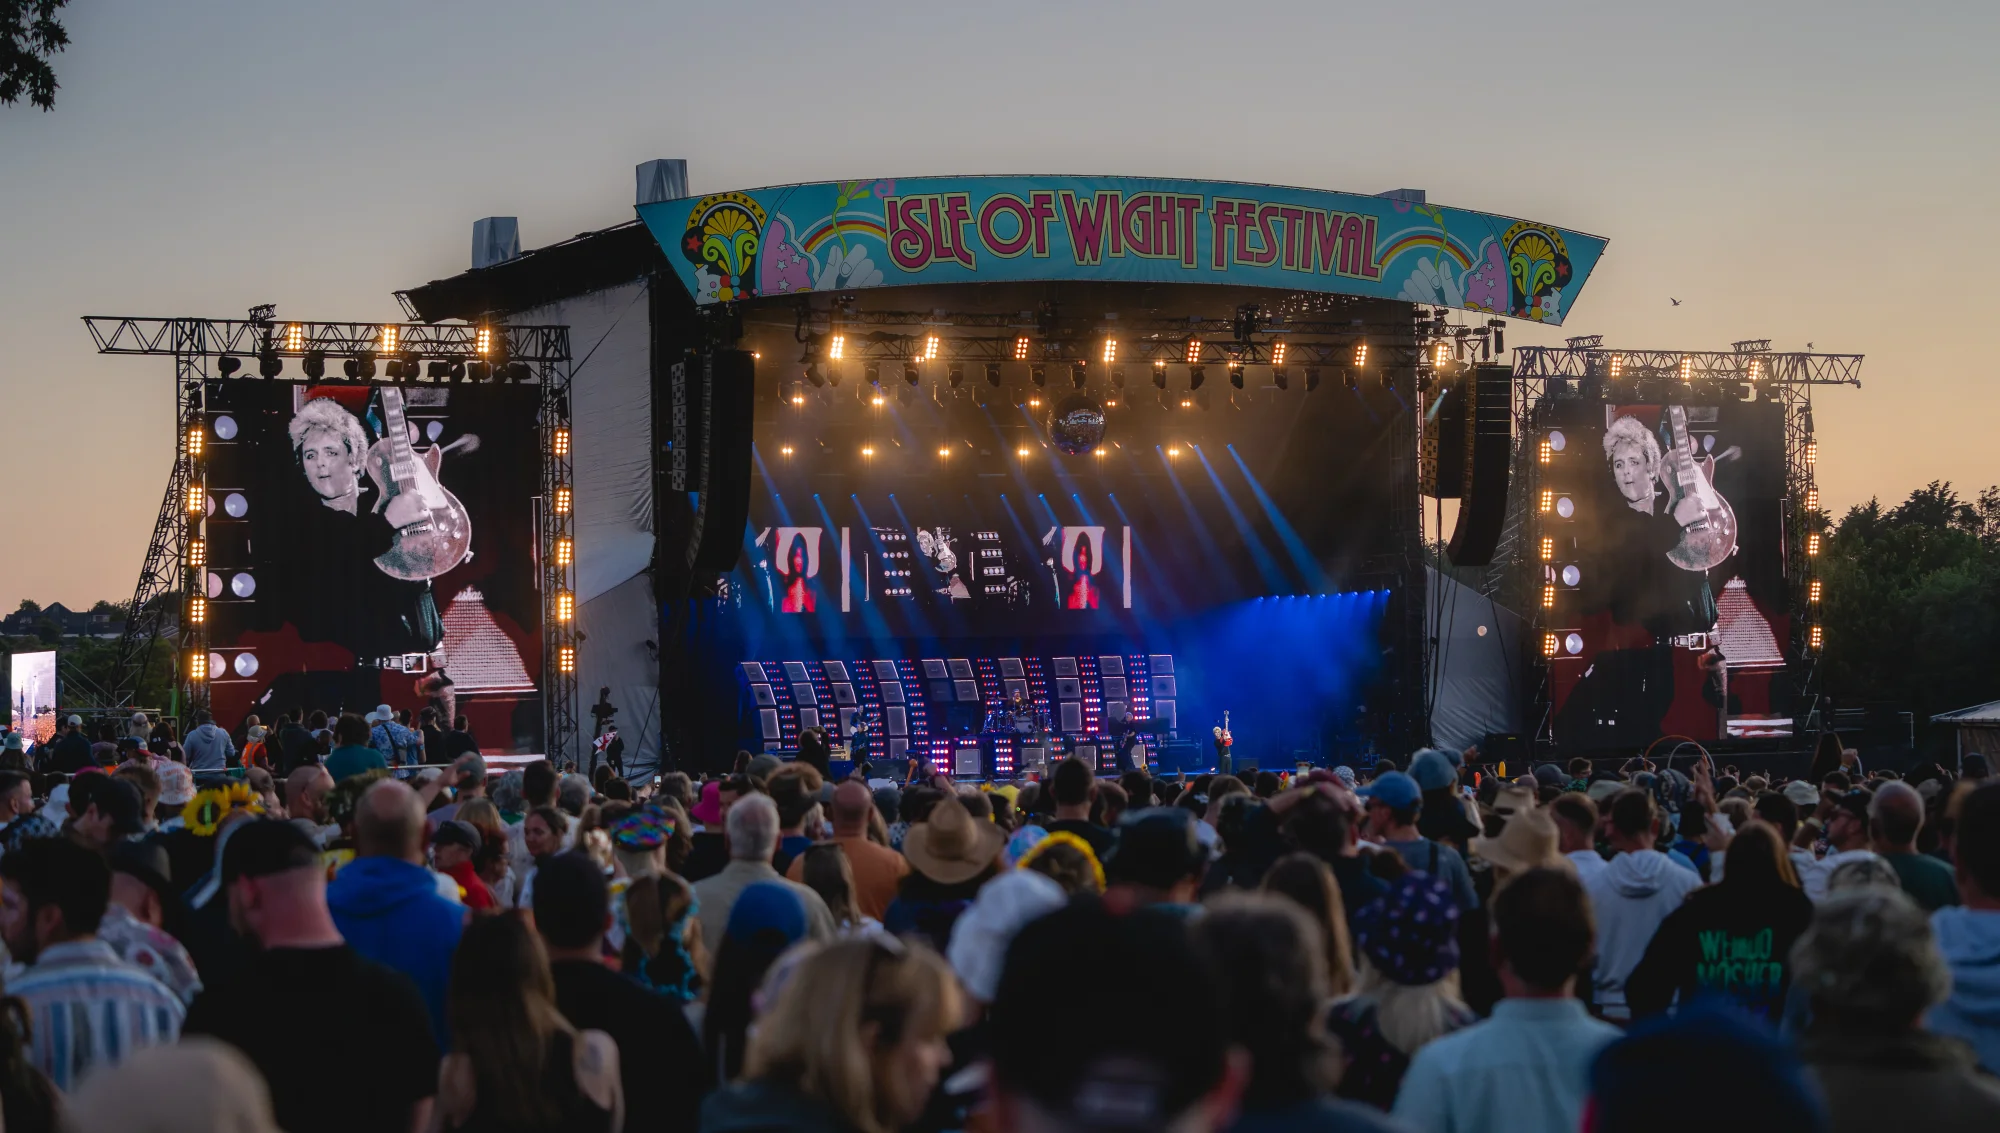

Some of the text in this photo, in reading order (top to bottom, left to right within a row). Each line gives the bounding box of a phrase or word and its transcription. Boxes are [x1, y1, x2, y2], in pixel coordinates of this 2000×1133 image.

[883, 190, 1382, 283] ISLE OF WIGHT FESTIVAL
